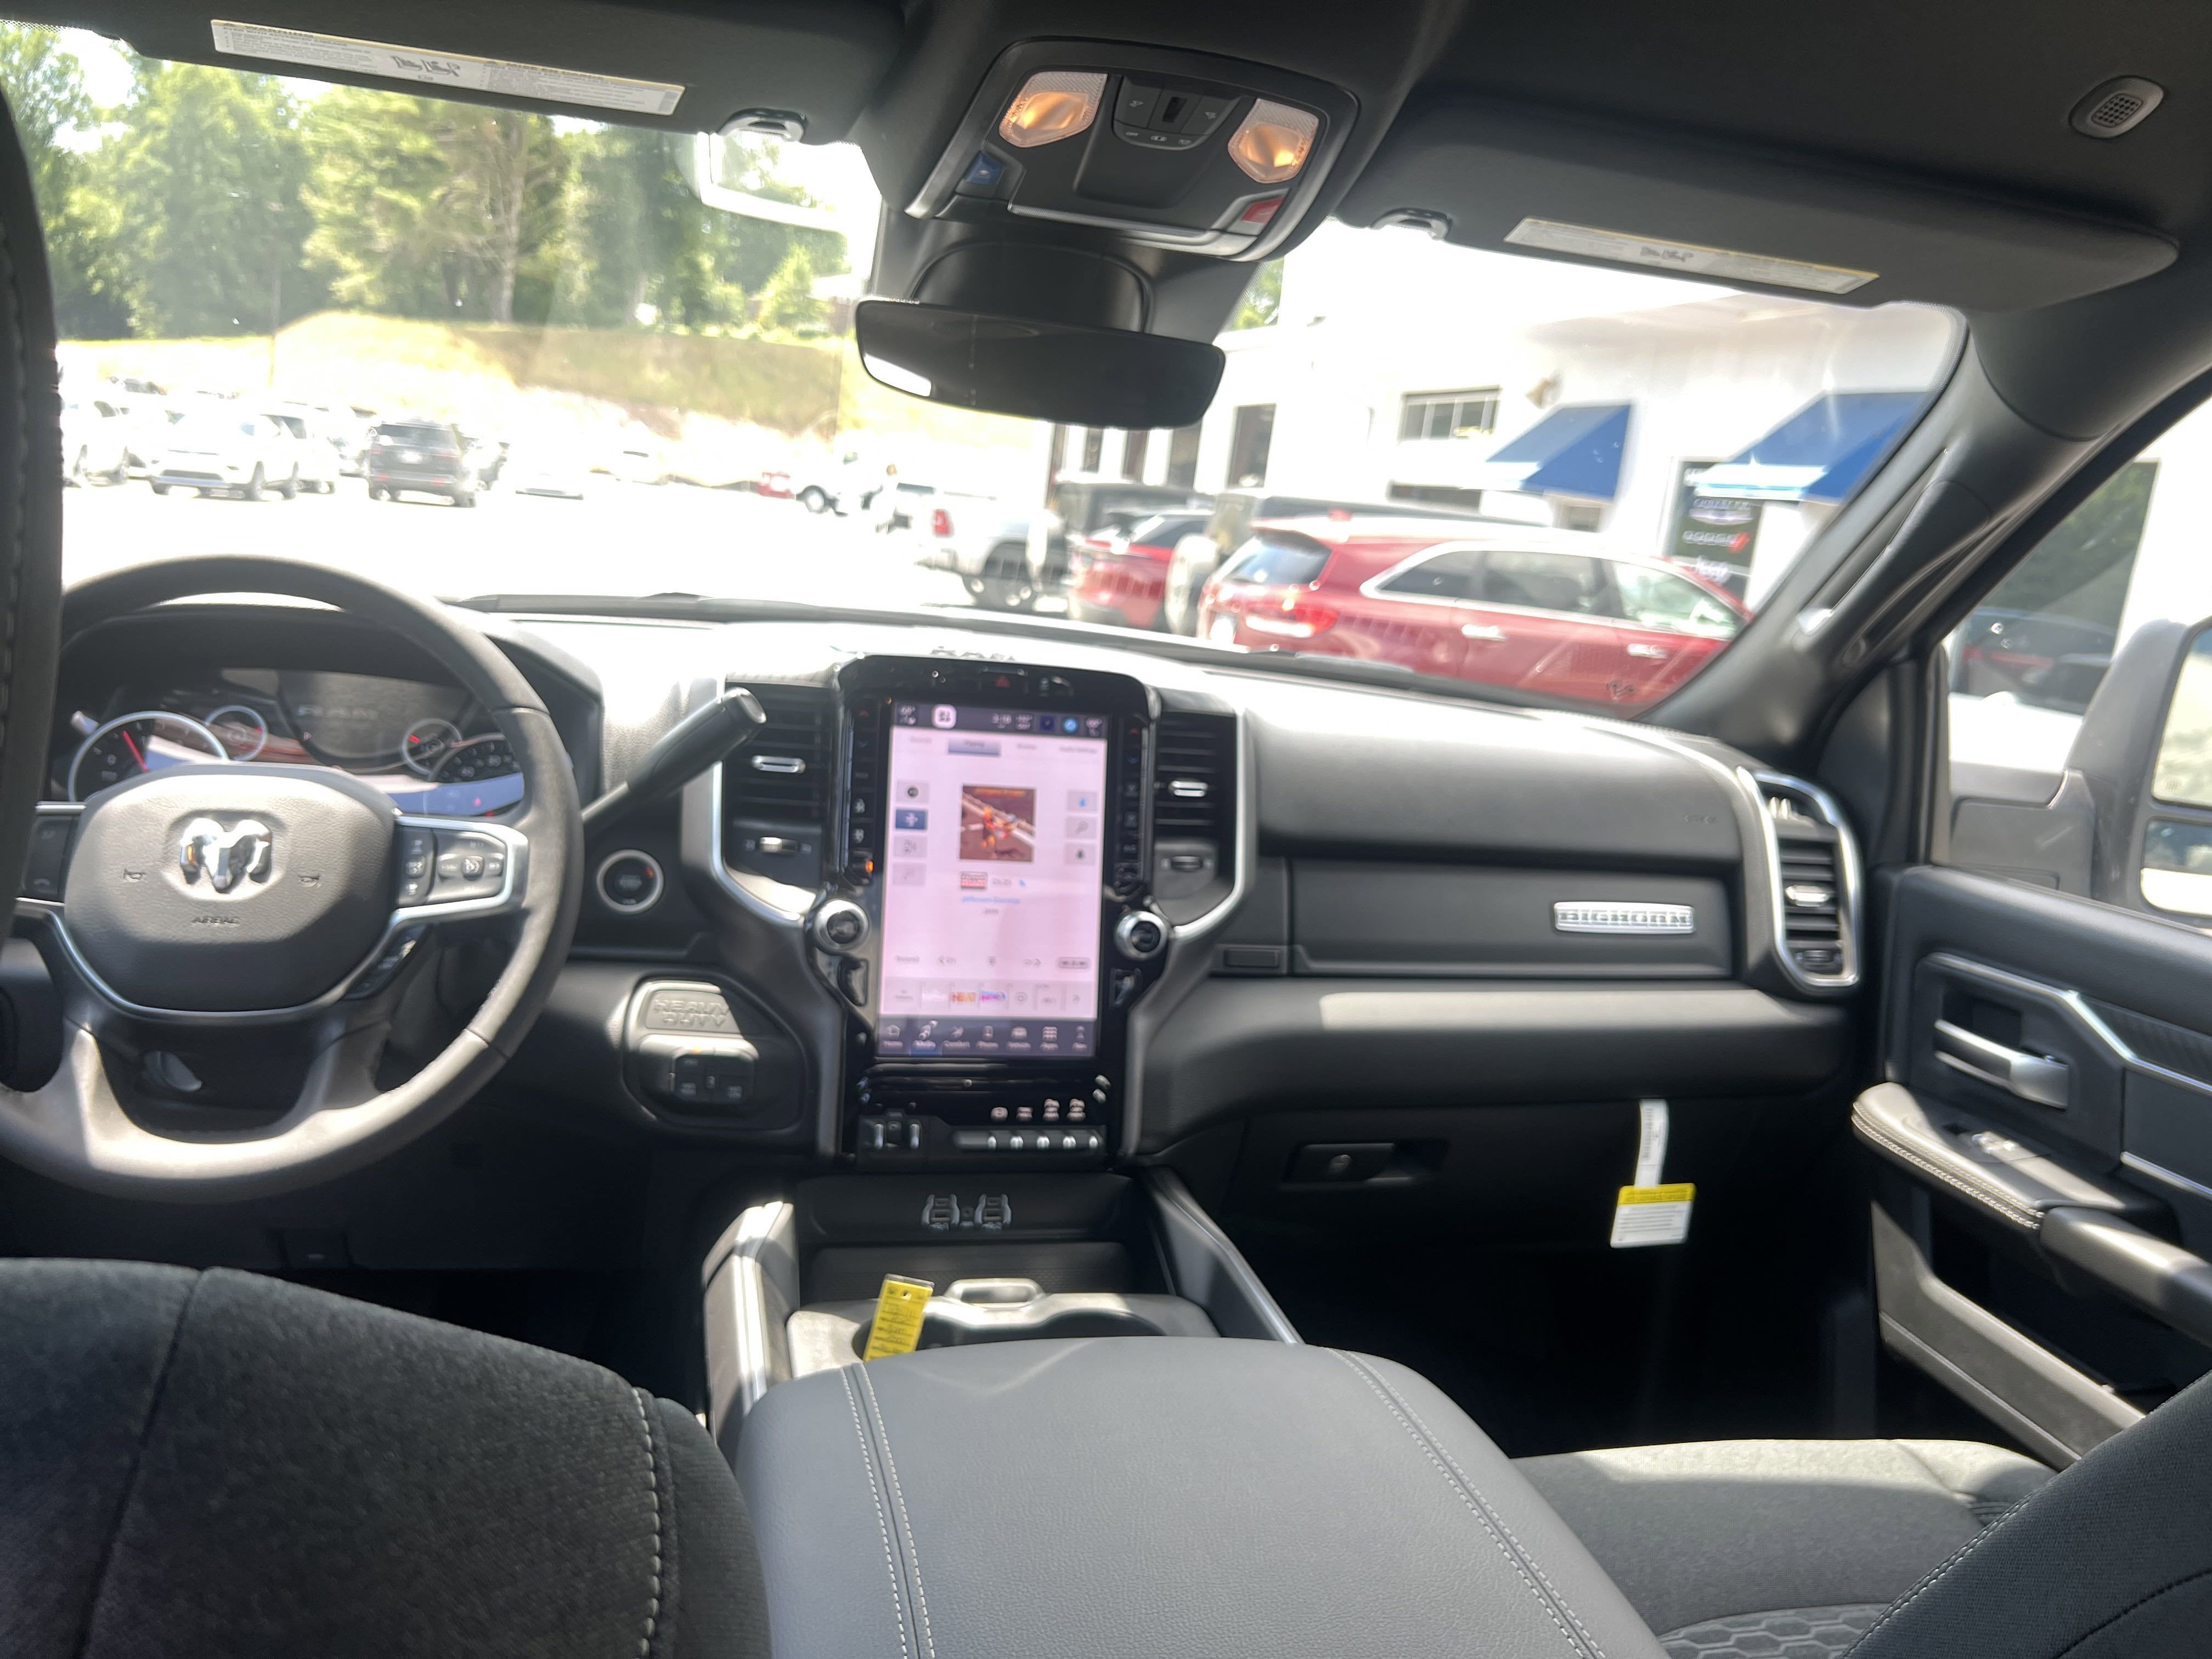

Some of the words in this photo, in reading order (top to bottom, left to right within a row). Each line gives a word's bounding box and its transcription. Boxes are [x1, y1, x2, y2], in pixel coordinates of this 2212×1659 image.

[1557, 909, 1690, 927] BIGHORN
[652, 999, 730, 1015] HEAVY
[662, 1011, 727, 1028] DUTY
